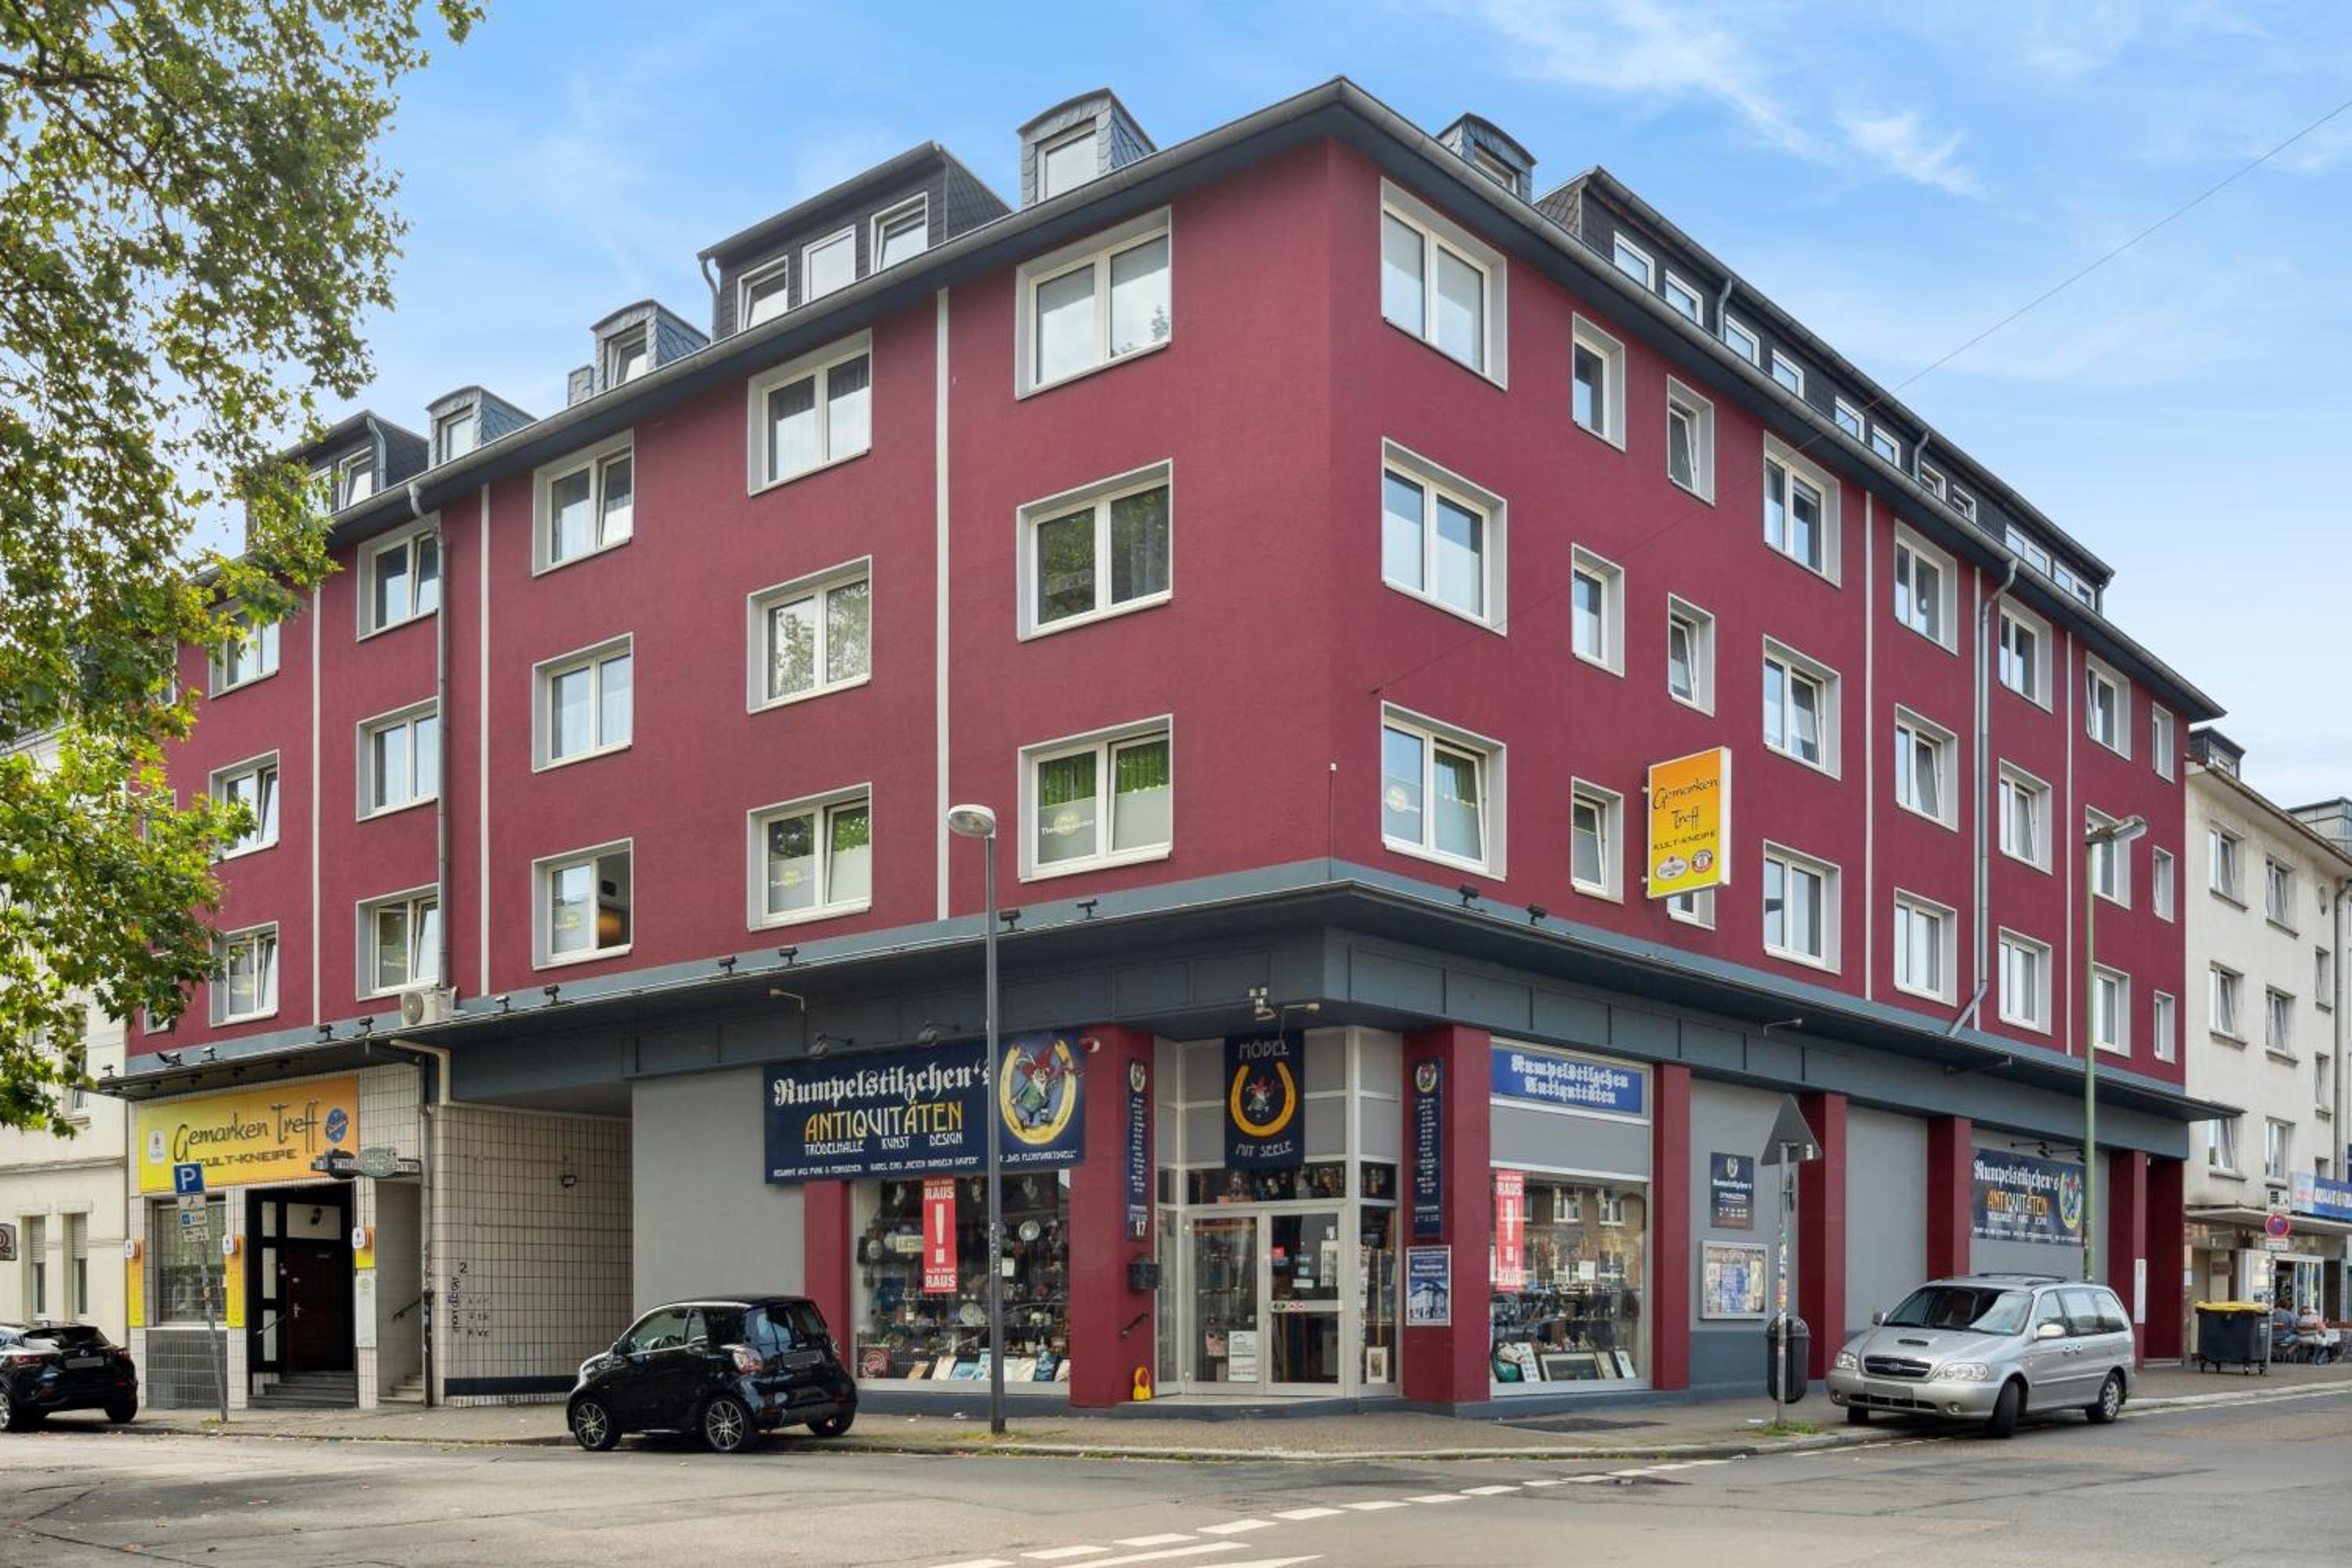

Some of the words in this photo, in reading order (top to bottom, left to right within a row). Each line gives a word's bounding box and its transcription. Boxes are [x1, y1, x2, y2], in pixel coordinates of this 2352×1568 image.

[1653, 778, 1718, 809] Gemarken
[1671, 805, 1698, 829] Treff
[173, 1112, 268, 1163] Gemarken
[270, 1101, 320, 1153] Treff
[805, 1099, 964, 1142] ANTIQUITÄTEN
[804, 1140, 864, 1156] TRÖDELHALLE
[881, 1136, 909, 1150] KUNST
[929, 1131, 963, 1147] DESIGN
[180, 1168, 196, 1190] P
[924, 1187, 954, 1200] RAUS
[926, 1276, 955, 1287] RAUS
